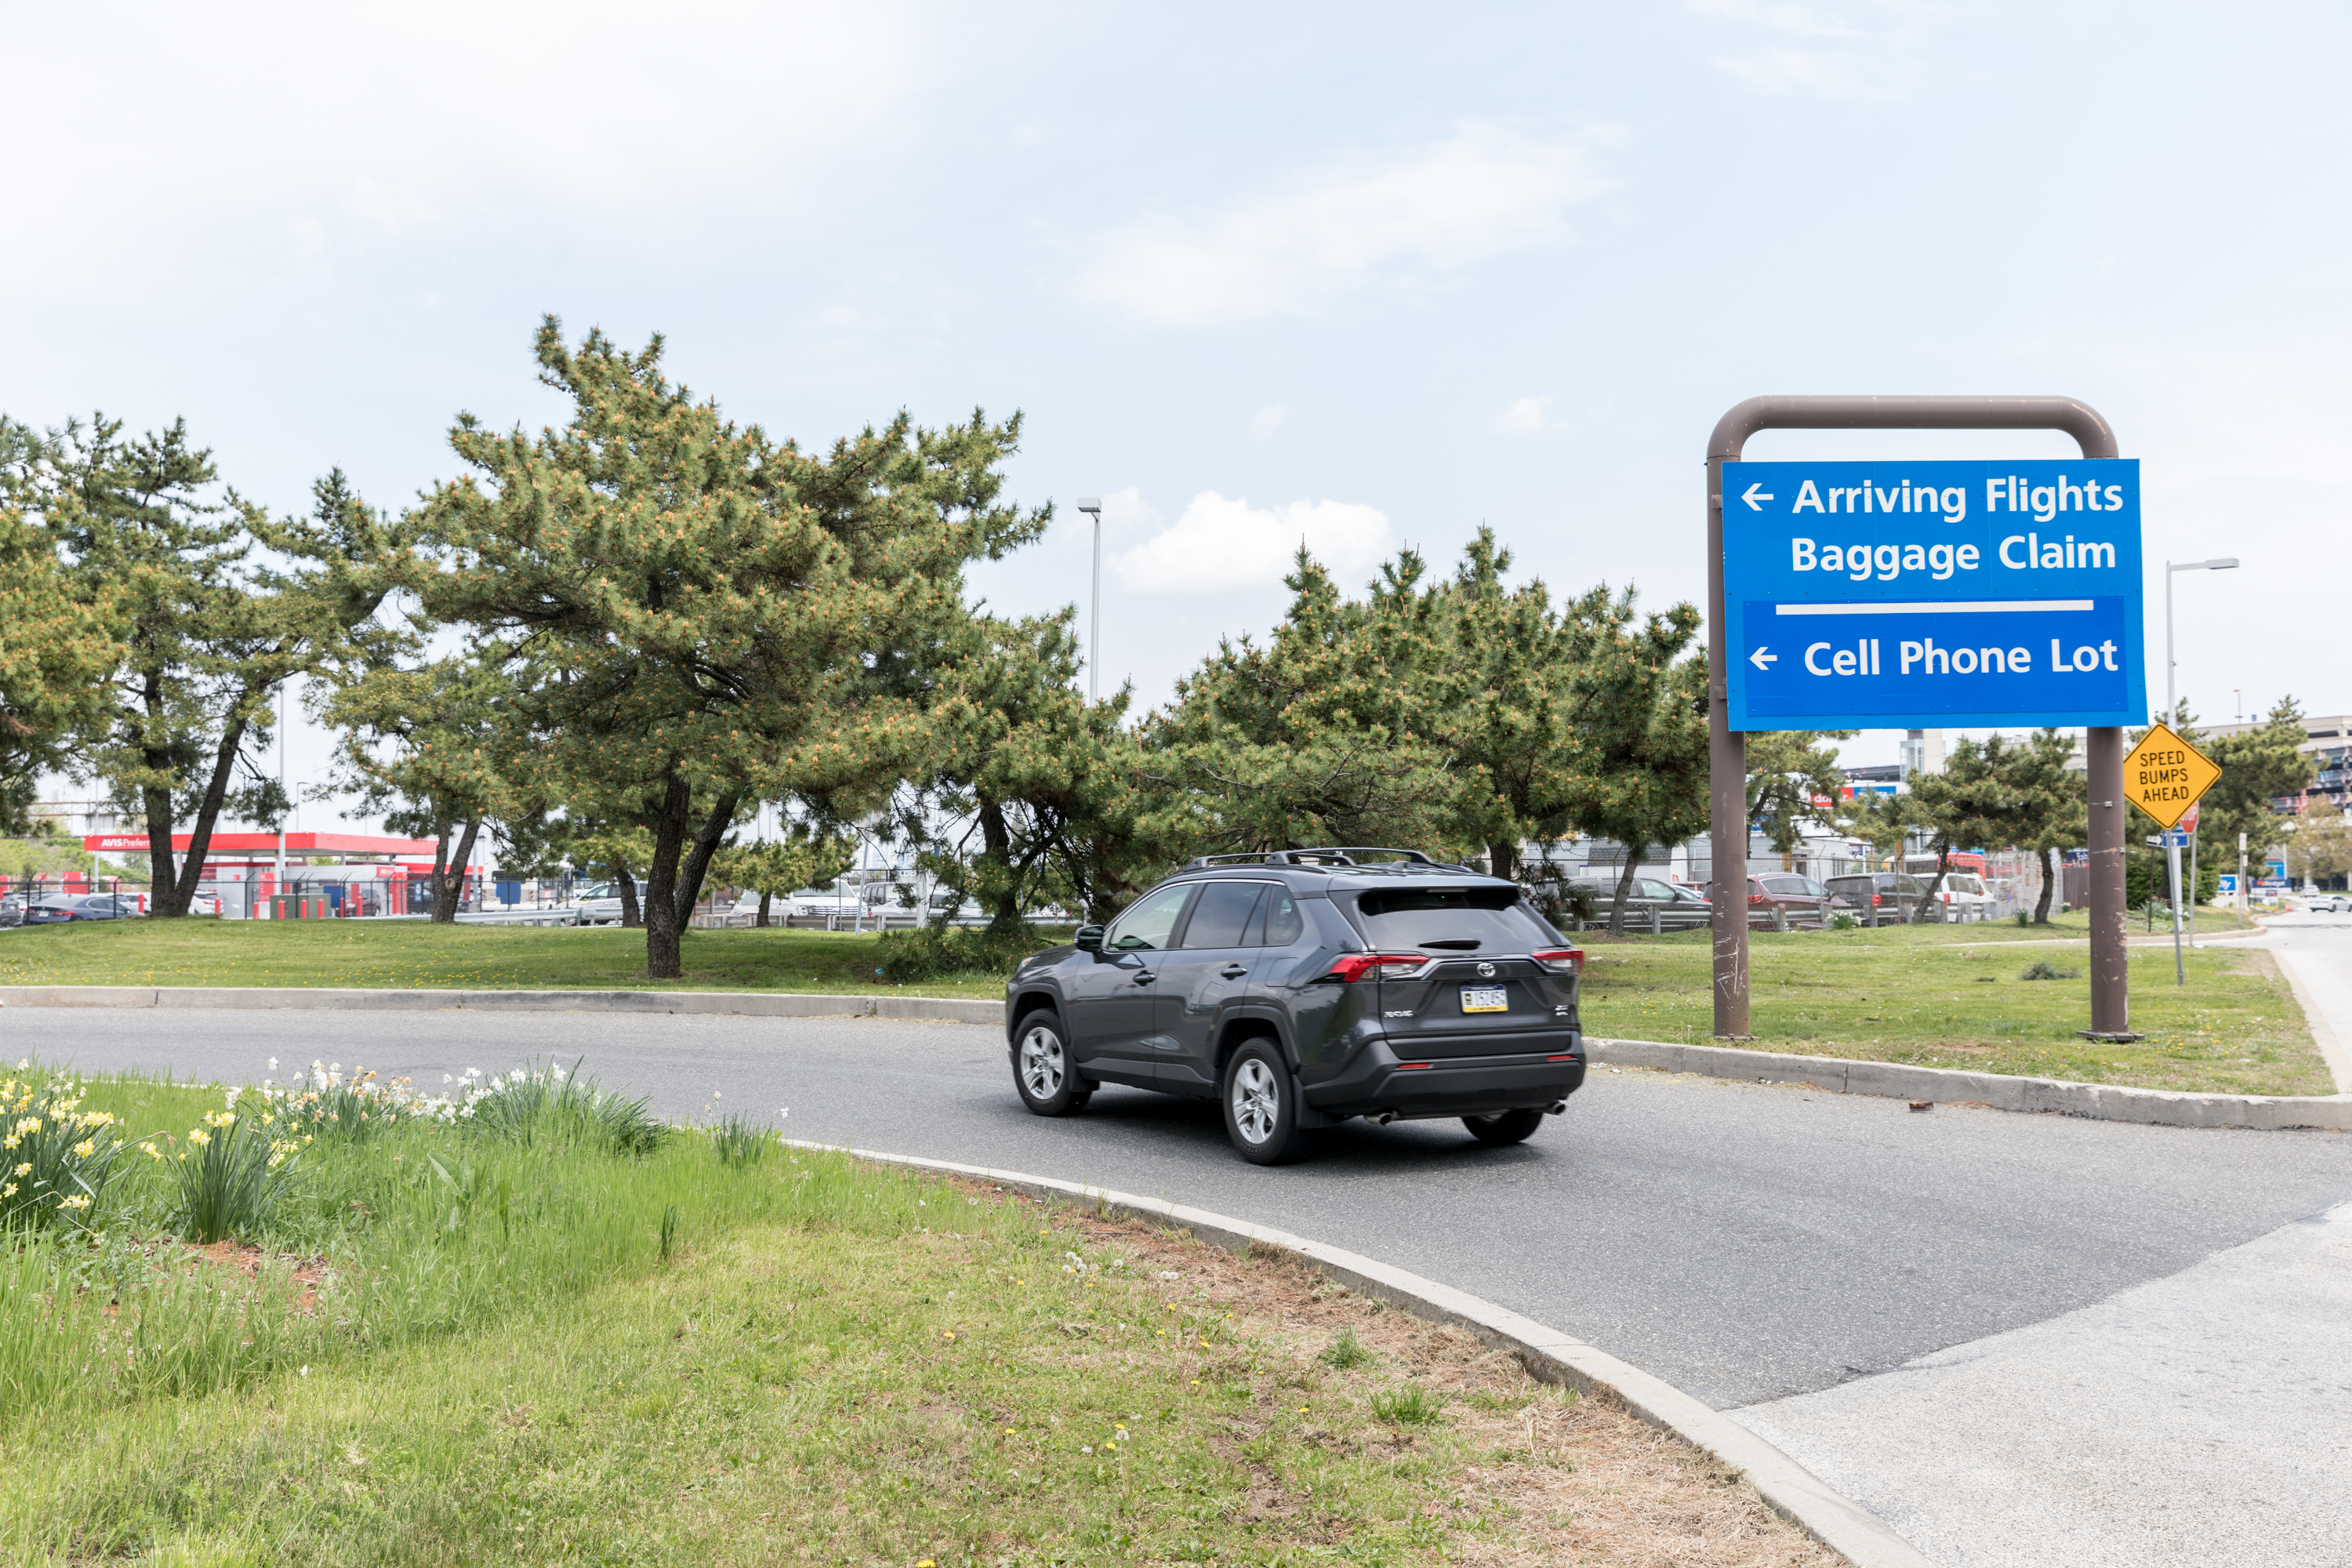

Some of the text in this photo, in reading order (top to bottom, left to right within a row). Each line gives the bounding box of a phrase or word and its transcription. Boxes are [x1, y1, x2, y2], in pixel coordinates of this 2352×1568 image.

[1792, 474, 2123, 524] Arriving Flights
[1792, 532, 2116, 581] Baggage Claim
[1804, 637, 2119, 677] Cell Phone Lot
[2140, 750, 2185, 767] SPEED
[2140, 768, 2188, 785] BUMPS
[2143, 786, 2189, 803] AHEAD
[101, 837, 151, 848] AVIS Preferr
